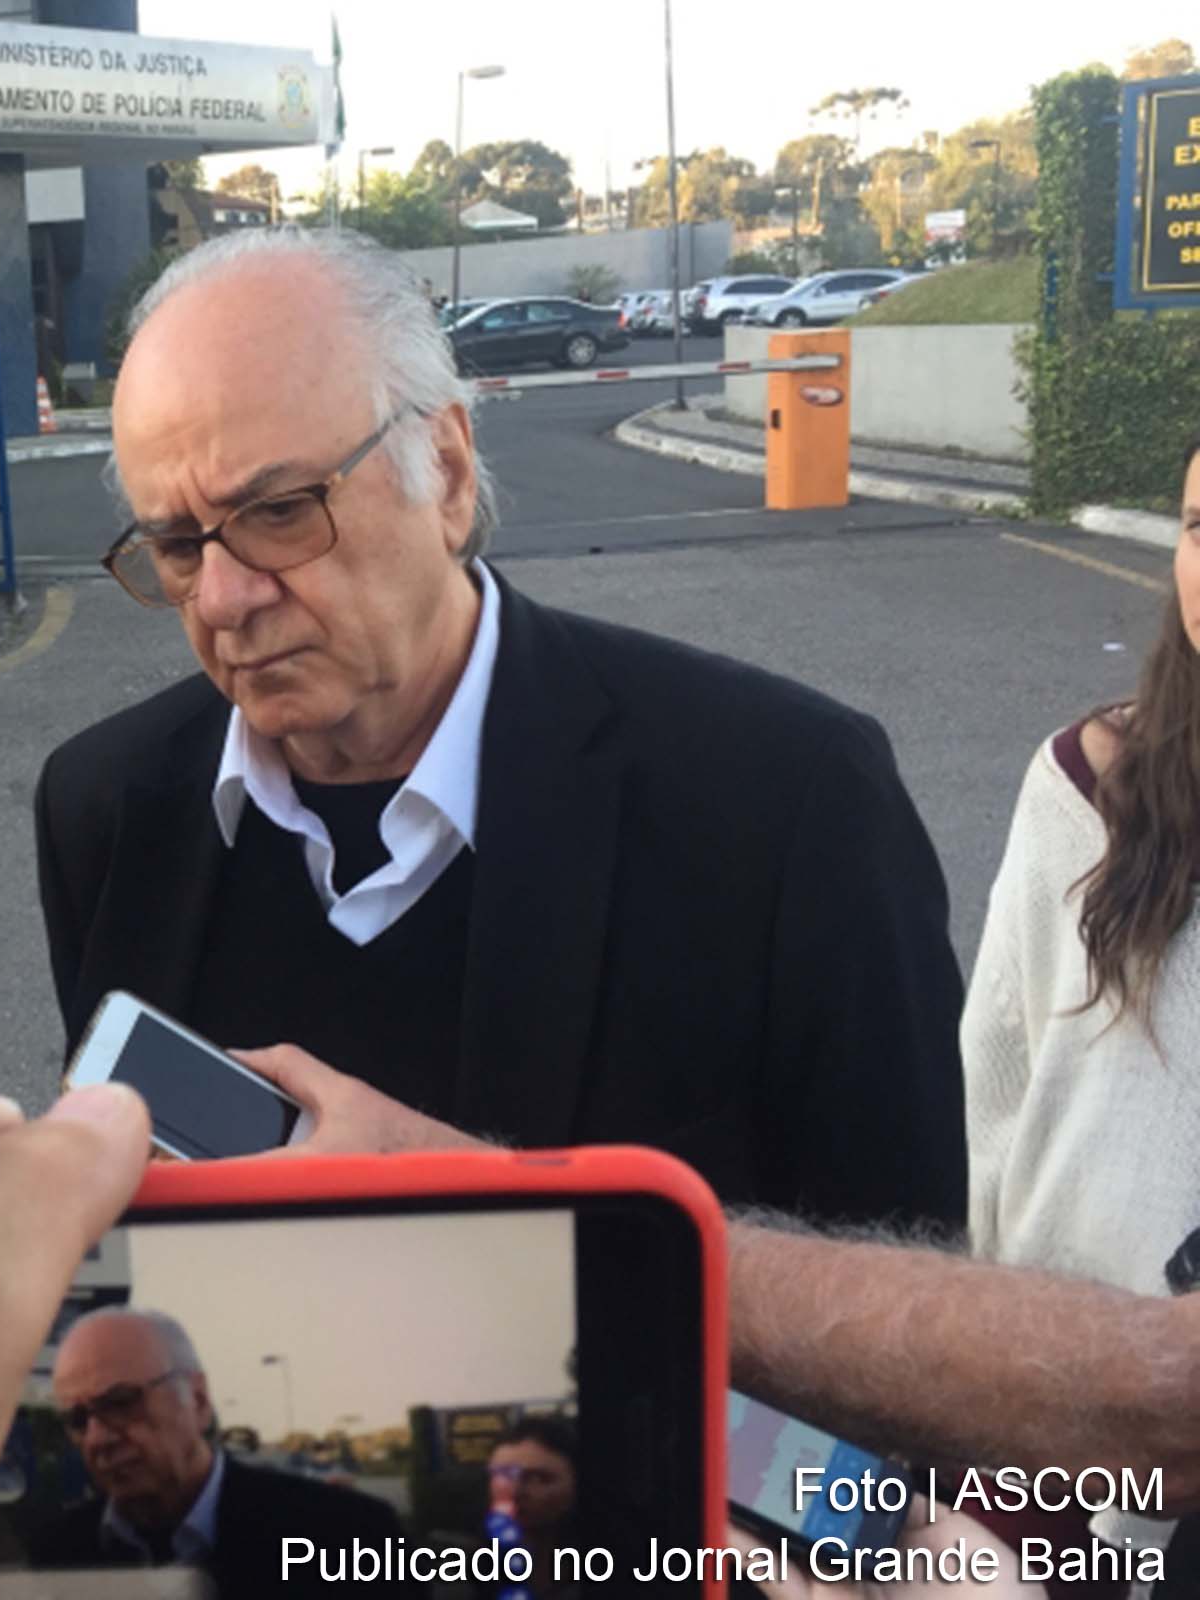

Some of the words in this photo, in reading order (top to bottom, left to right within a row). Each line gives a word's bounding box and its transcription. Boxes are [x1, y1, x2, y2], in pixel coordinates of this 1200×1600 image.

[102, 49, 127, 71] DA
[135, 53, 207, 81] JUSTIÇA
[82, 92, 106, 115] DE
[114, 90, 183, 118] POLÍCIA
[190, 98, 266, 122] FEDERAL
